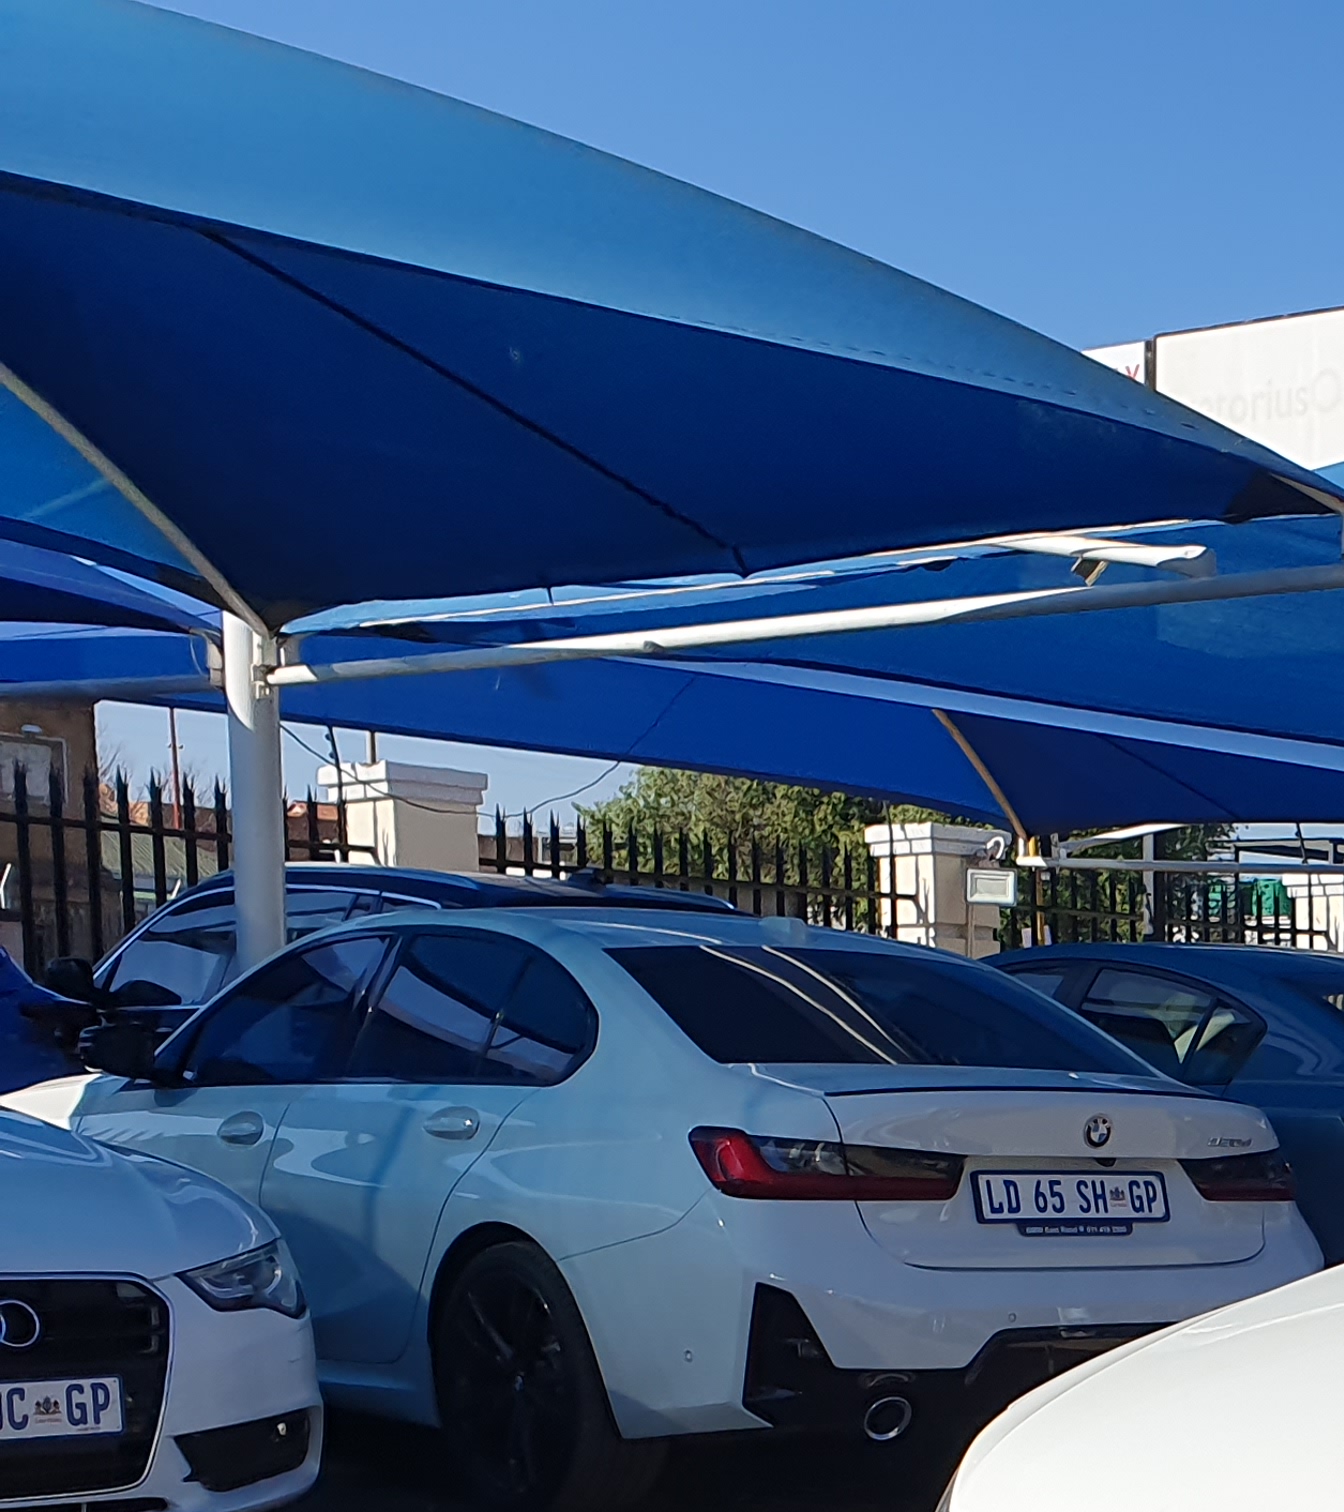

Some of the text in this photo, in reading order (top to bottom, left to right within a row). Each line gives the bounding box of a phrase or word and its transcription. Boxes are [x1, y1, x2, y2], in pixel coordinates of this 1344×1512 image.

[985, 1179, 1157, 1214] LD 65 SH GP
[0, 1381, 111, 1431] C GP
